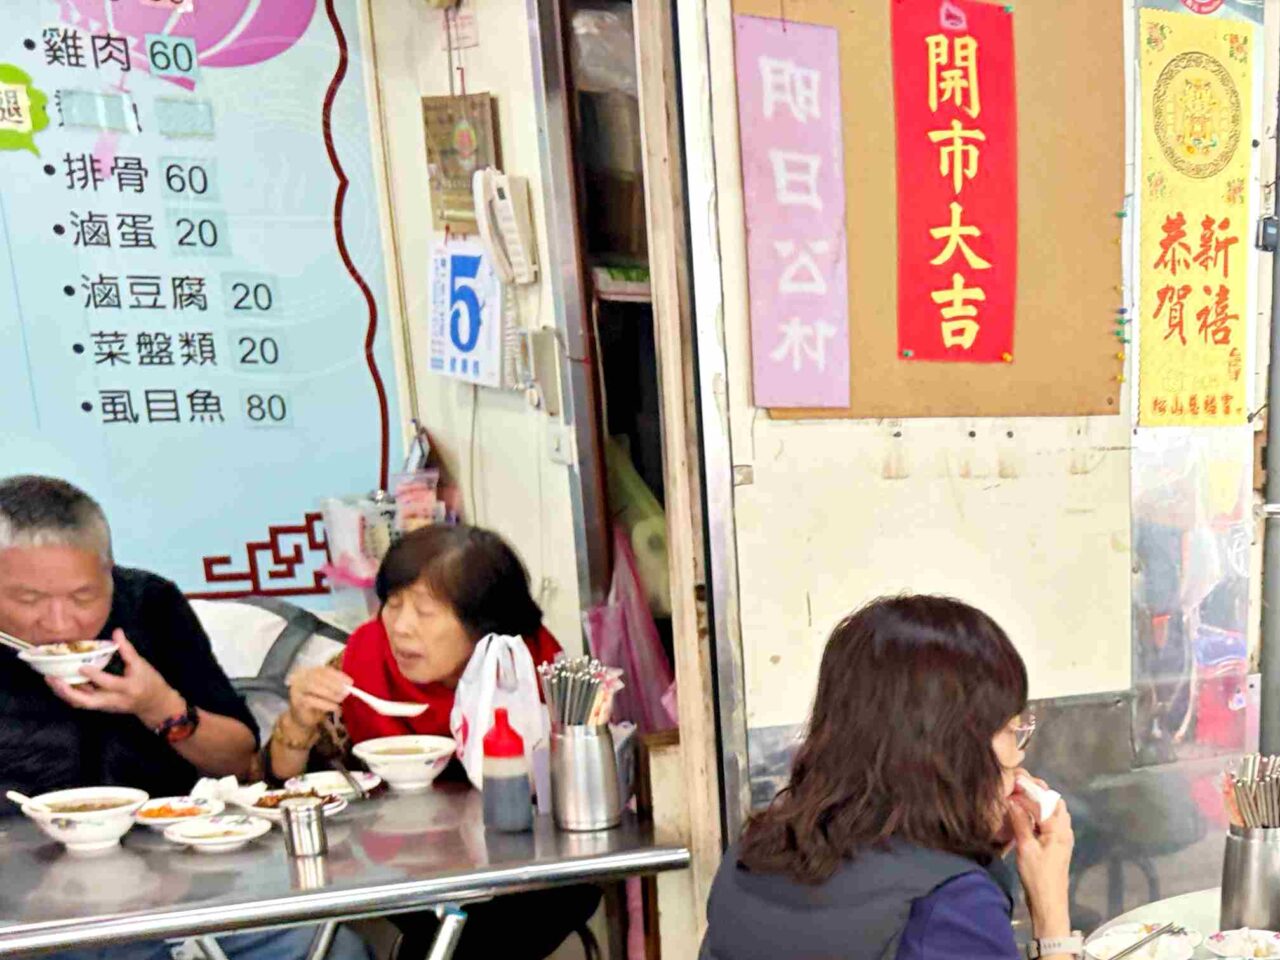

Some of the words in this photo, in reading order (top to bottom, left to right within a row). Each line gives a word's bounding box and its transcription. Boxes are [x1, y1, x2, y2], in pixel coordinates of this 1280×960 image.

[42, 27, 131, 71] 雞肉
[150, 40, 193, 72] 60
[63, 152, 149, 193] 排骨
[166, 165, 208, 194] 60
[925, 34, 992, 350] 開市大吉
[70, 210, 157, 250] 滷蛋
[176, 218, 218, 248] 20
[81, 273, 209, 312] 滷豆腐
[232, 283, 273, 311] 20
[1153, 211, 1191, 346] 恭賀
[1193, 214, 1239, 346] 新禧
[450, 254, 482, 352] 5
[90, 330, 218, 367] 菜盤類
[239, 336, 279, 365] 20
[98, 388, 226, 424] 虱目魚
[247, 394, 287, 421] 80
